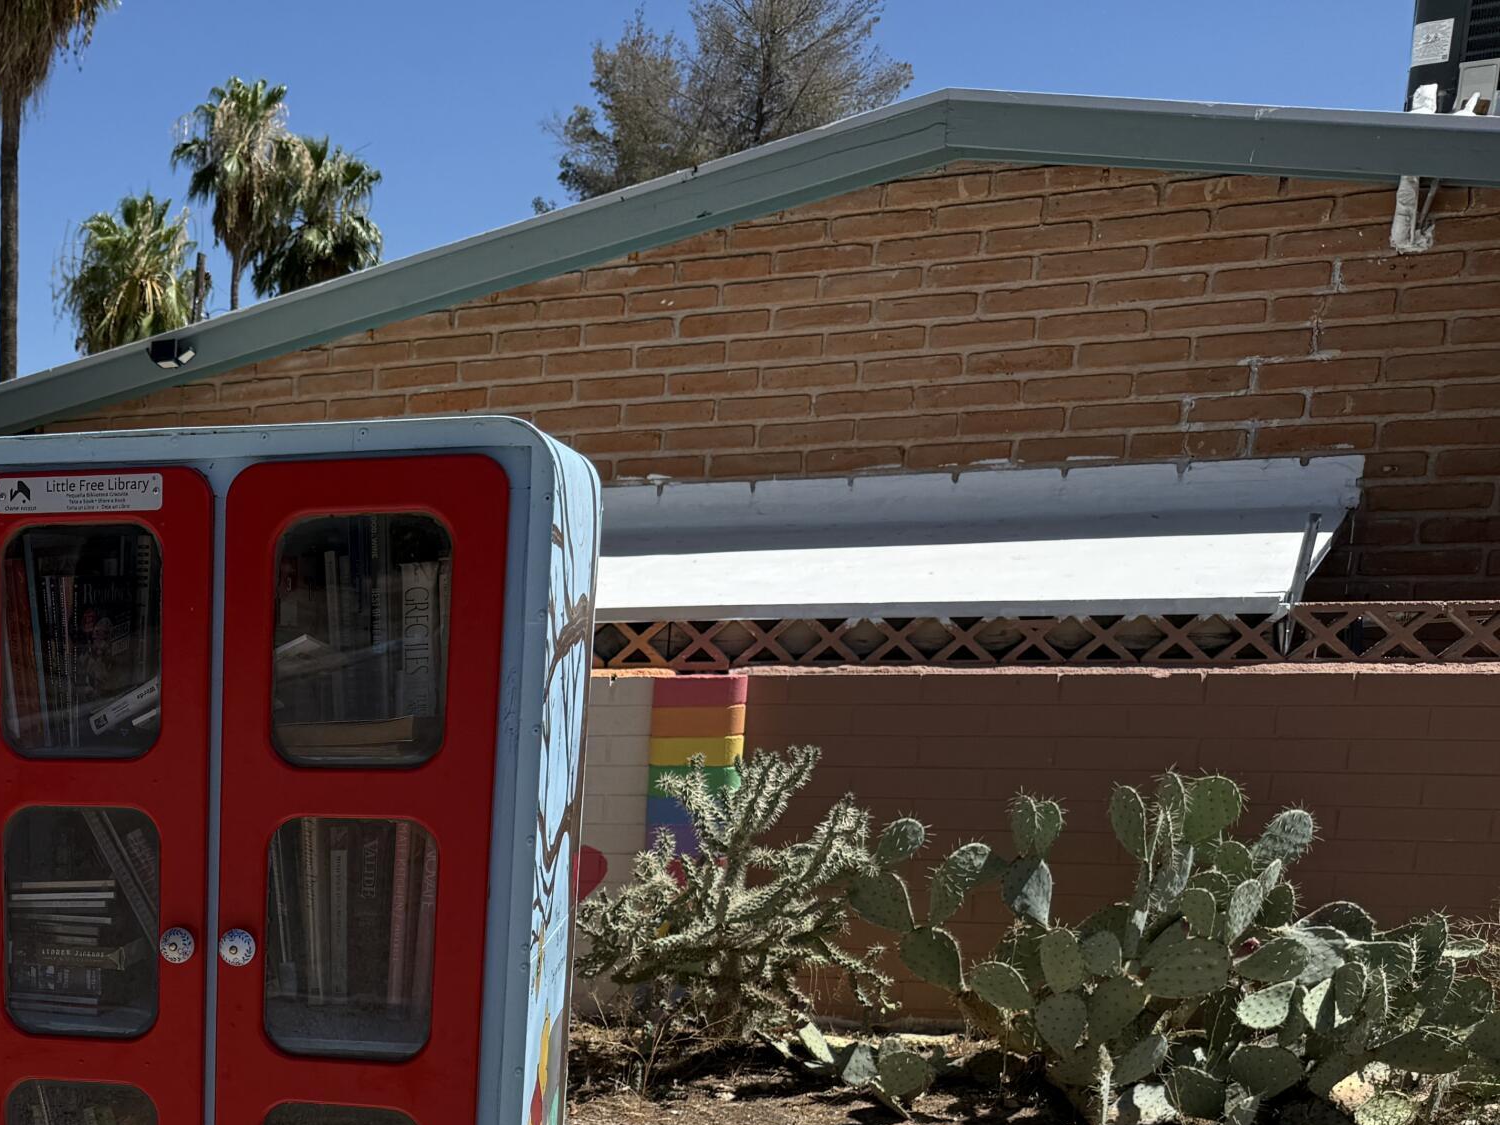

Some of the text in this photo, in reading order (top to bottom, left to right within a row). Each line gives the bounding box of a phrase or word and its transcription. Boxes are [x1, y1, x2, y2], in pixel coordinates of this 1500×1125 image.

[46, 477, 149, 493] Little Free Library
[404, 587, 430, 639] GREG
[404, 643, 430, 676] ILES
